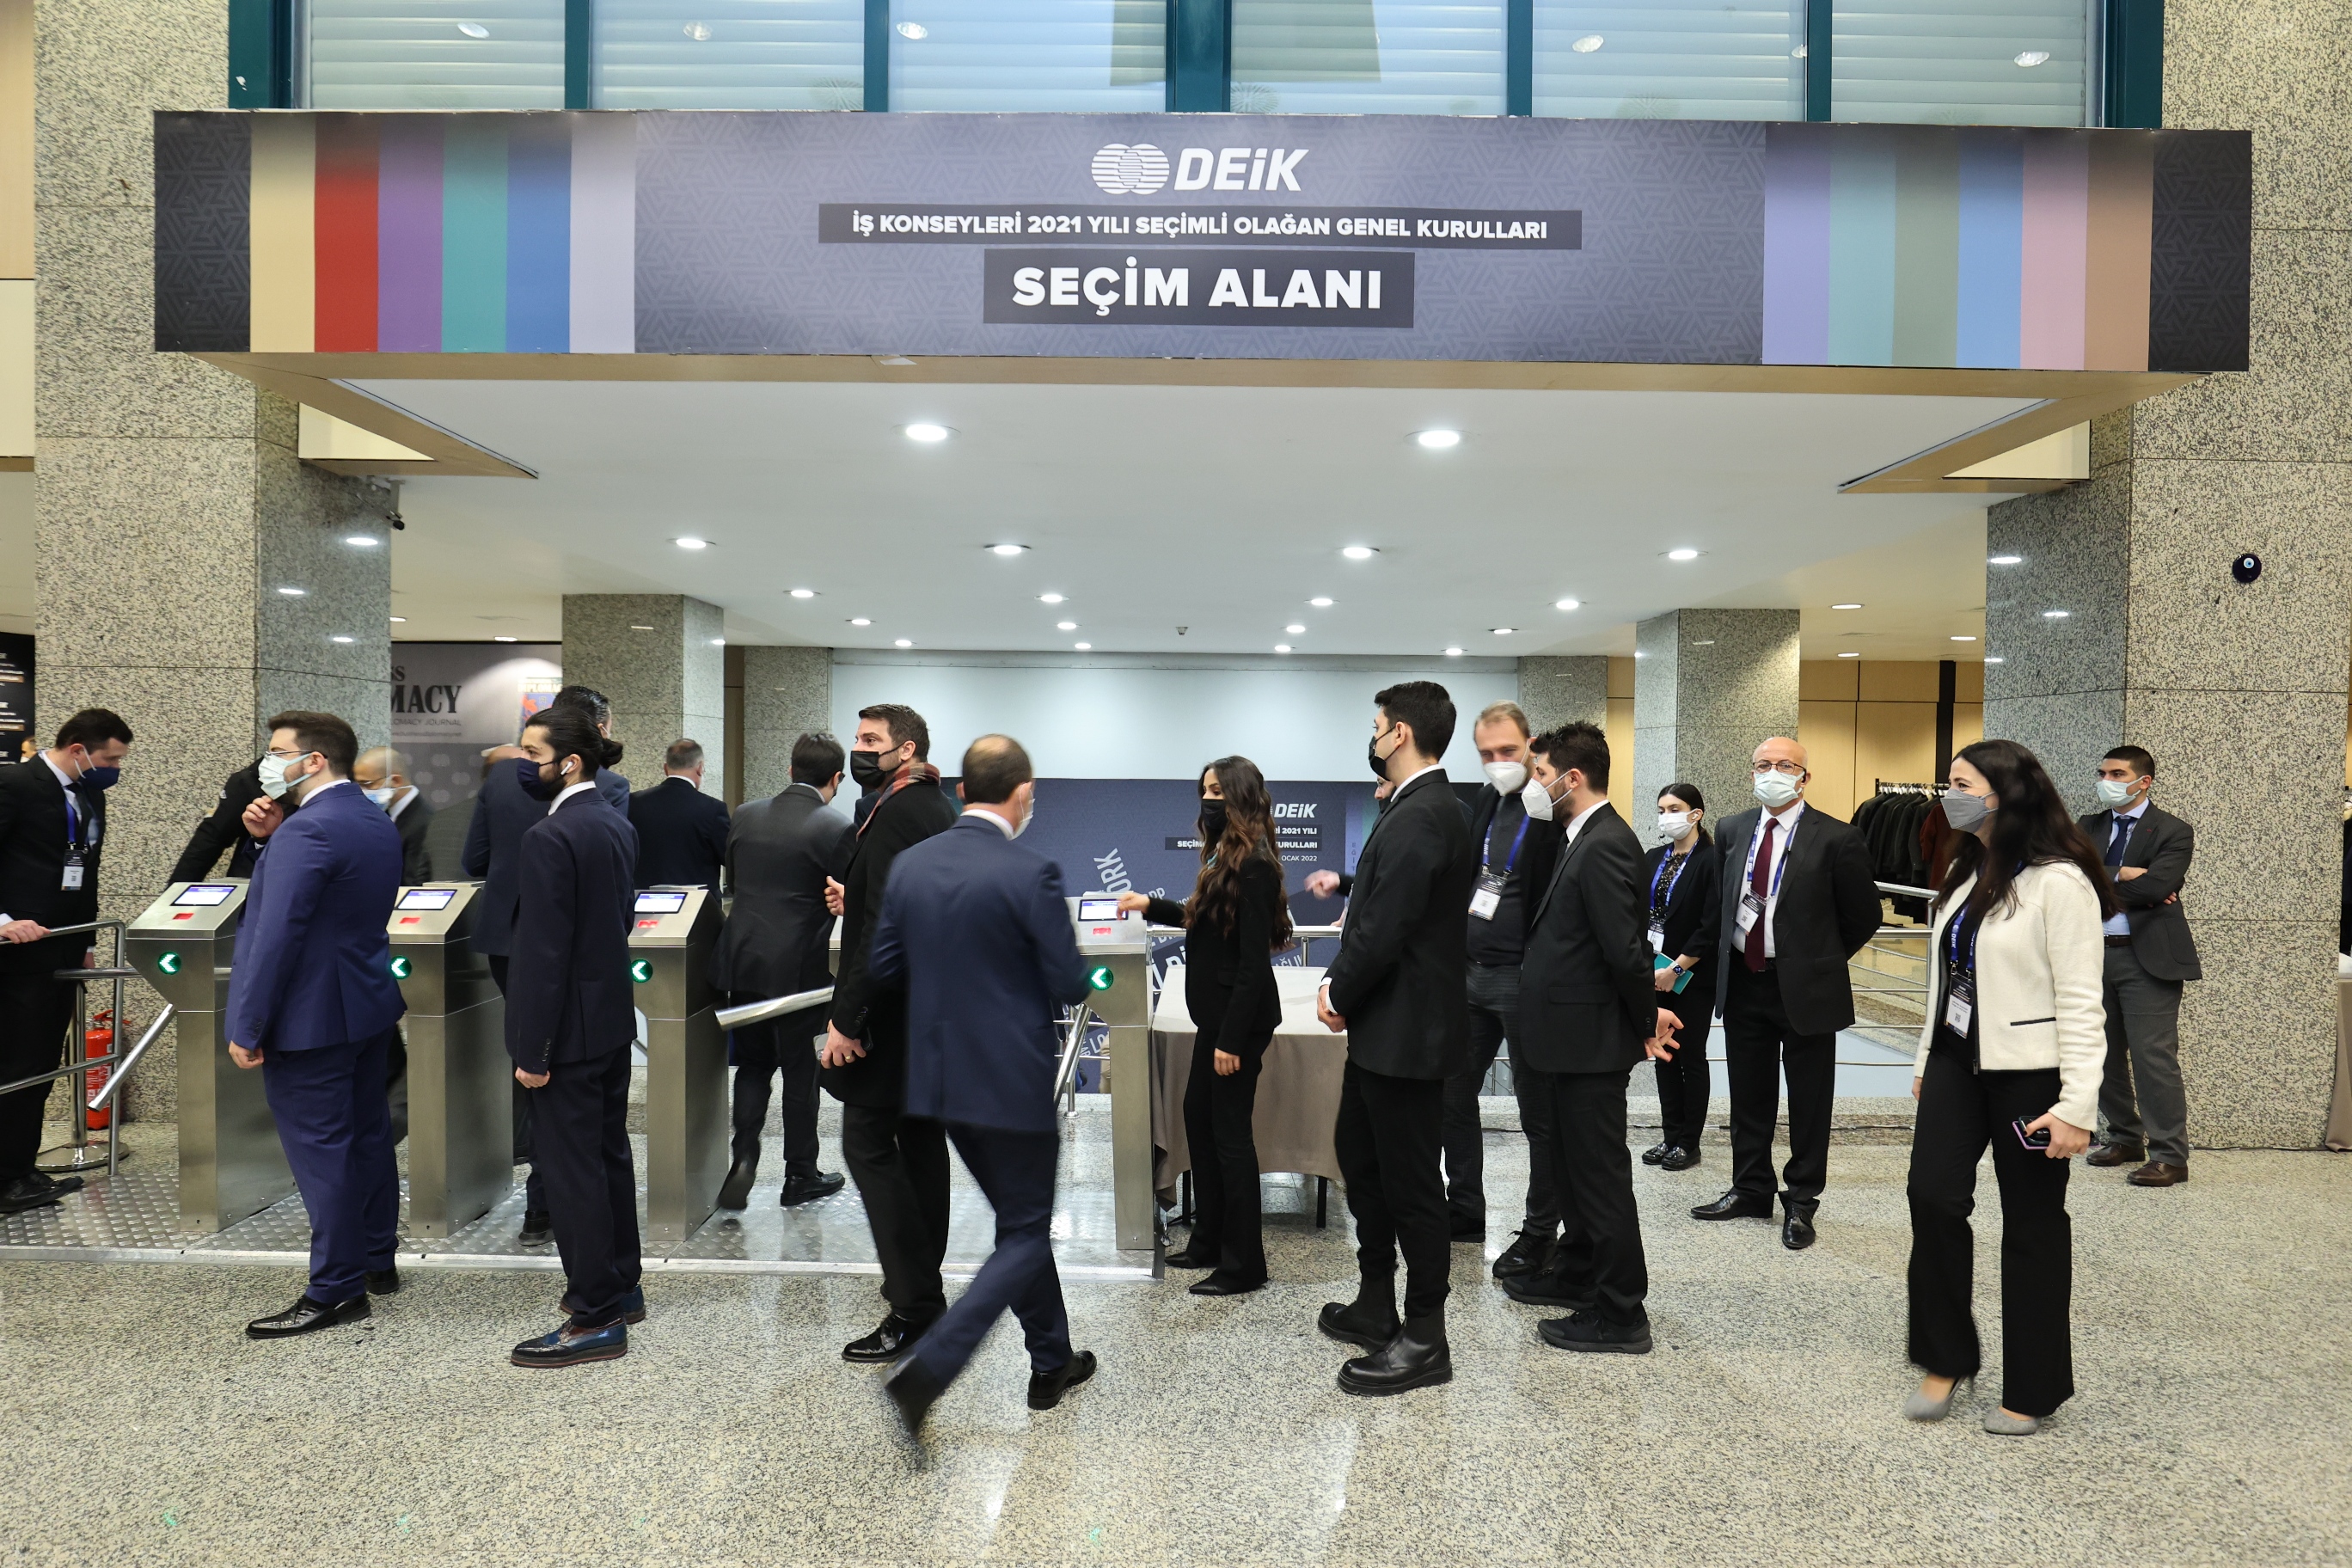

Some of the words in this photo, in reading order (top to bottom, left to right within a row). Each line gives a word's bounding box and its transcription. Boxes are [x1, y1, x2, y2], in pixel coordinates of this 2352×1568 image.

[853, 210, 874, 237] İŞ
[879, 211, 1021, 234] KONSEYLERİ
[1027, 215, 1081, 233] 2021
[1087, 216, 1130, 234] YILI
[1135, 211, 1228, 239] SEÇİMLİ
[1233, 213, 1331, 236] OLAĞAN
[1336, 217, 1411, 236] GENEL
[1417, 219, 1547, 239] KURULLARI
[1012, 255, 1189, 316] SEÇİM
[1208, 268, 1381, 309] ALANI
